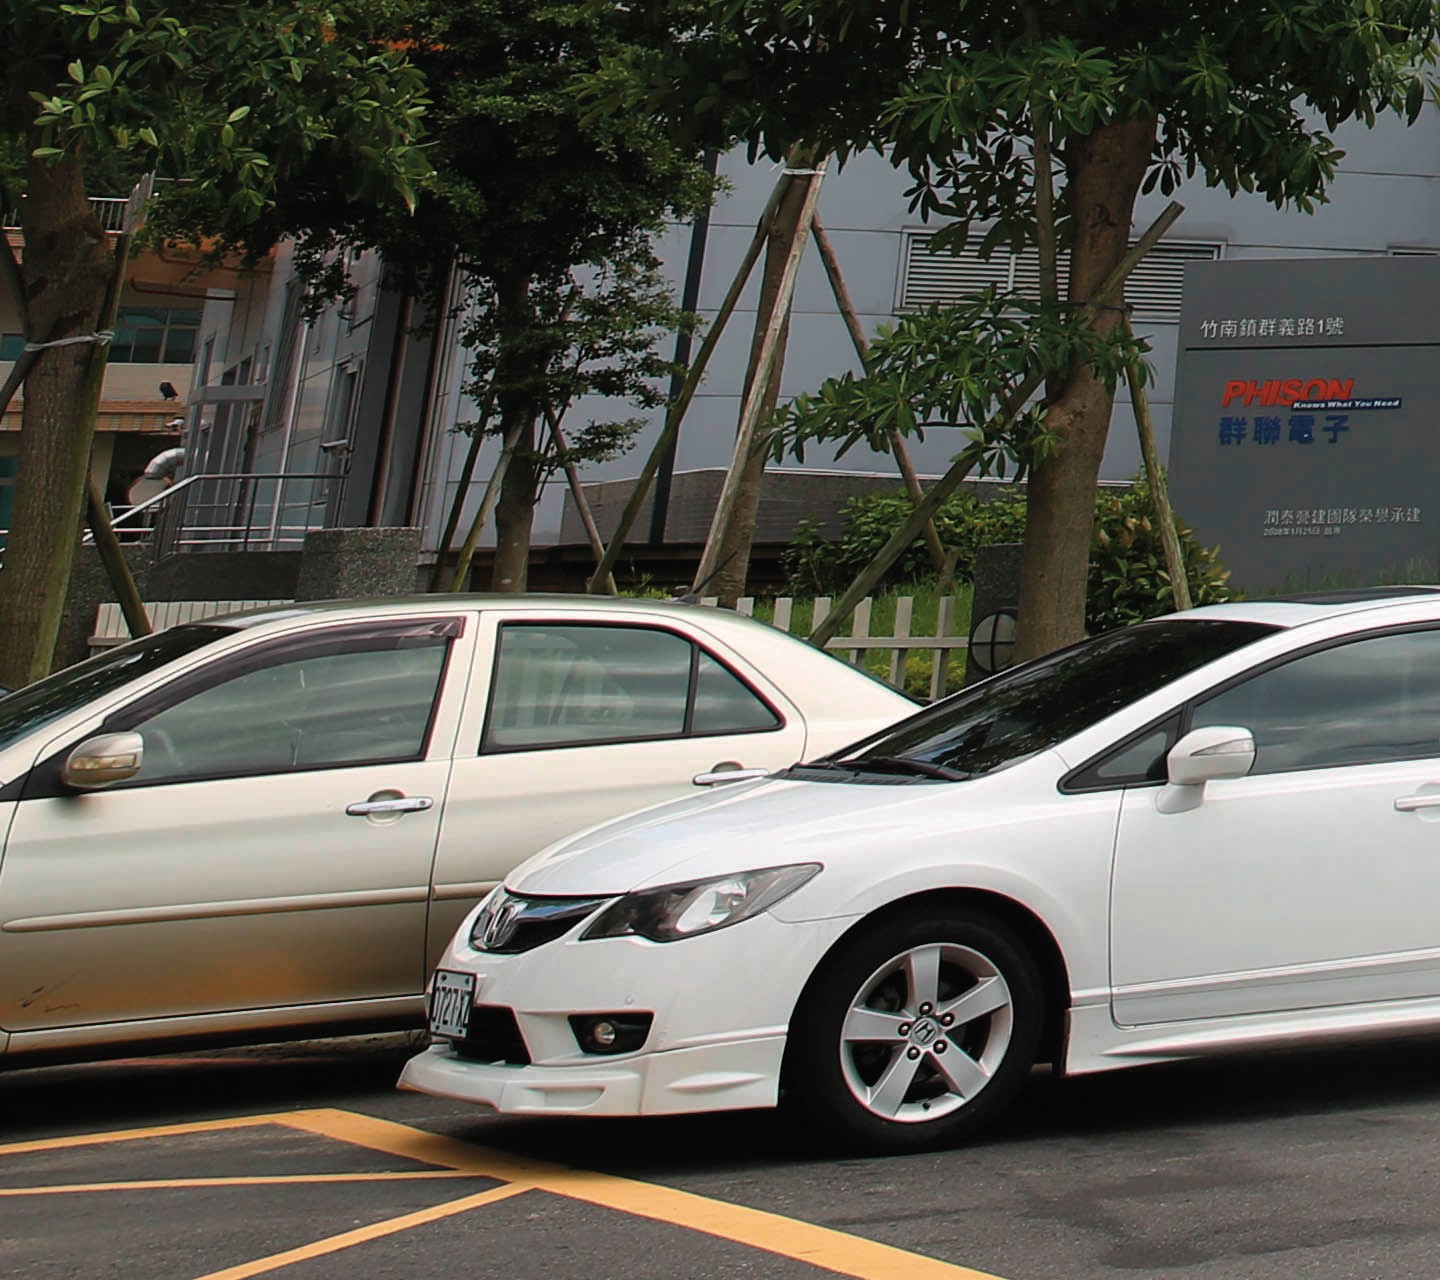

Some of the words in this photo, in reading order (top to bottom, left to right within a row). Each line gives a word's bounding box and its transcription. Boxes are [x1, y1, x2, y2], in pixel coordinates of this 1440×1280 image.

[1220, 378, 1355, 408] PHISON
[1293, 400, 1326, 409] Knows
[1327, 399, 1352, 408] What
[1354, 399, 1372, 407] You
[1218, 414, 1350, 445] 群聯電子
